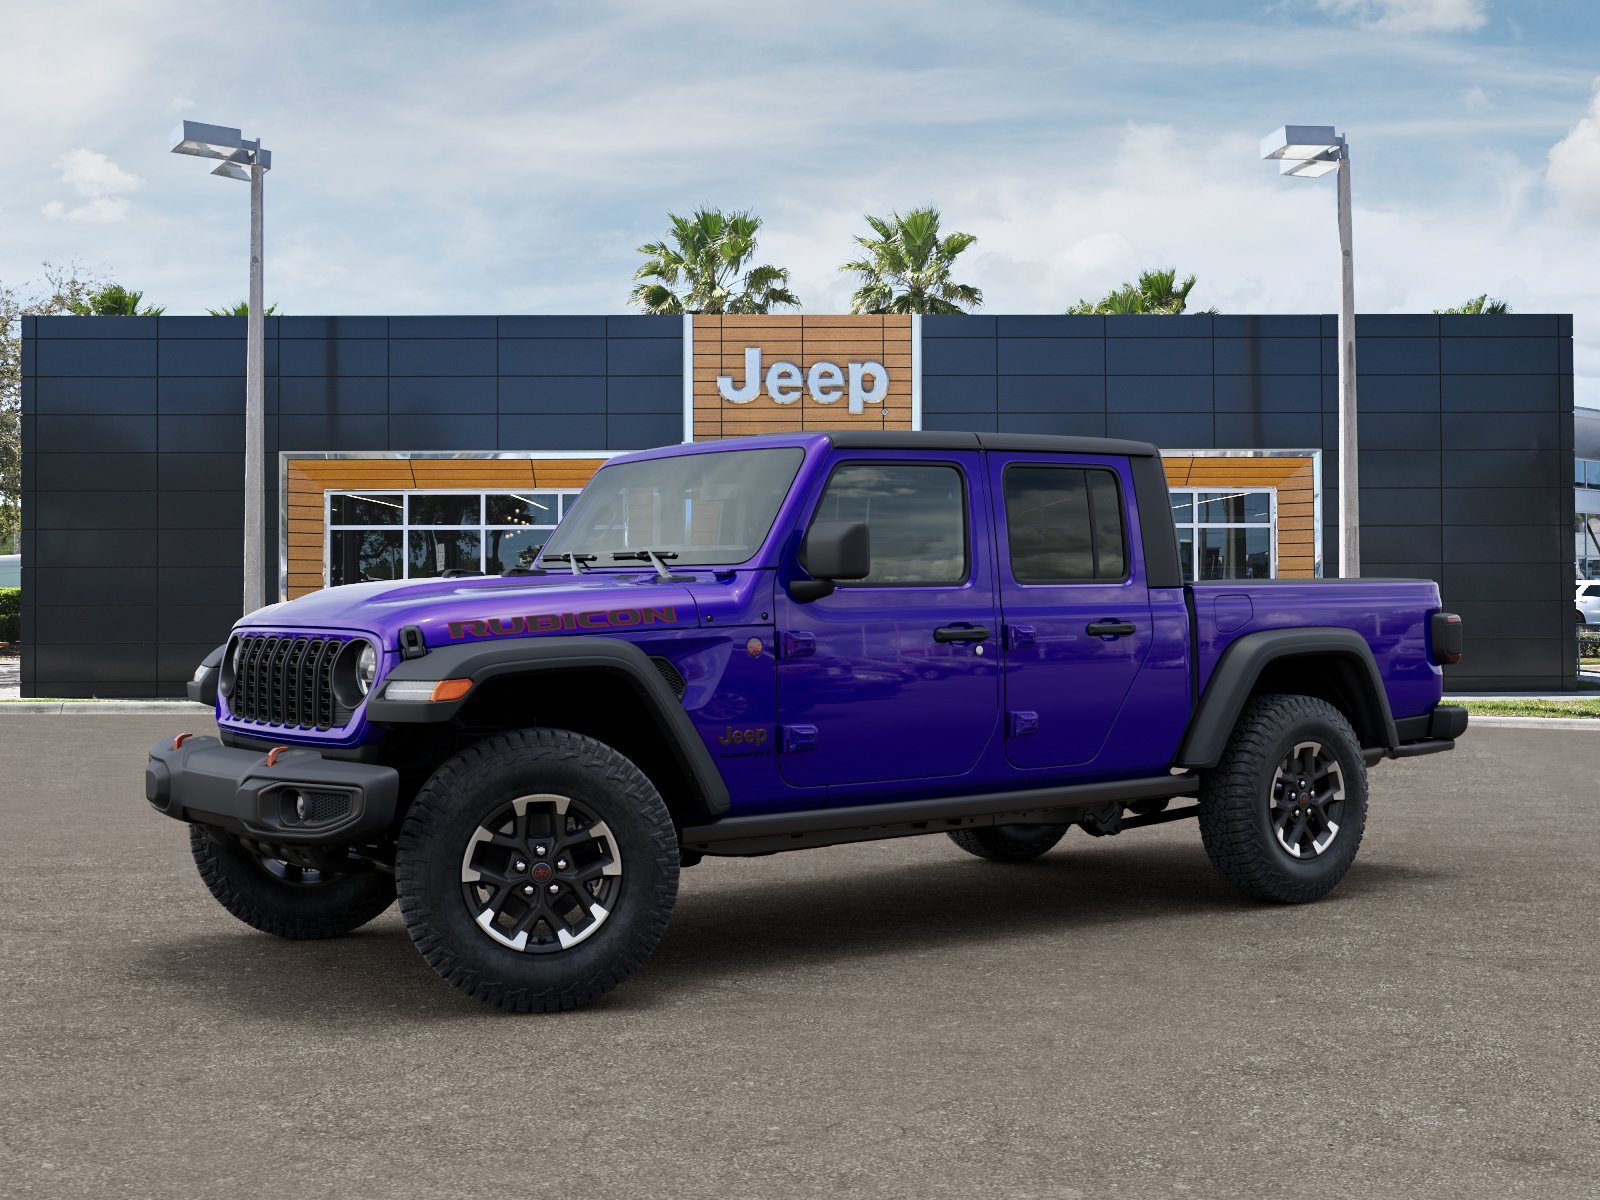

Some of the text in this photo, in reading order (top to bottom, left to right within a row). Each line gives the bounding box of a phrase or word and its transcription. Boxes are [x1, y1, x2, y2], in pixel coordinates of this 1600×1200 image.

[716, 347, 889, 414] Jeep
[448, 606, 677, 639] RUBICON
[719, 726, 767, 746] Jeep
